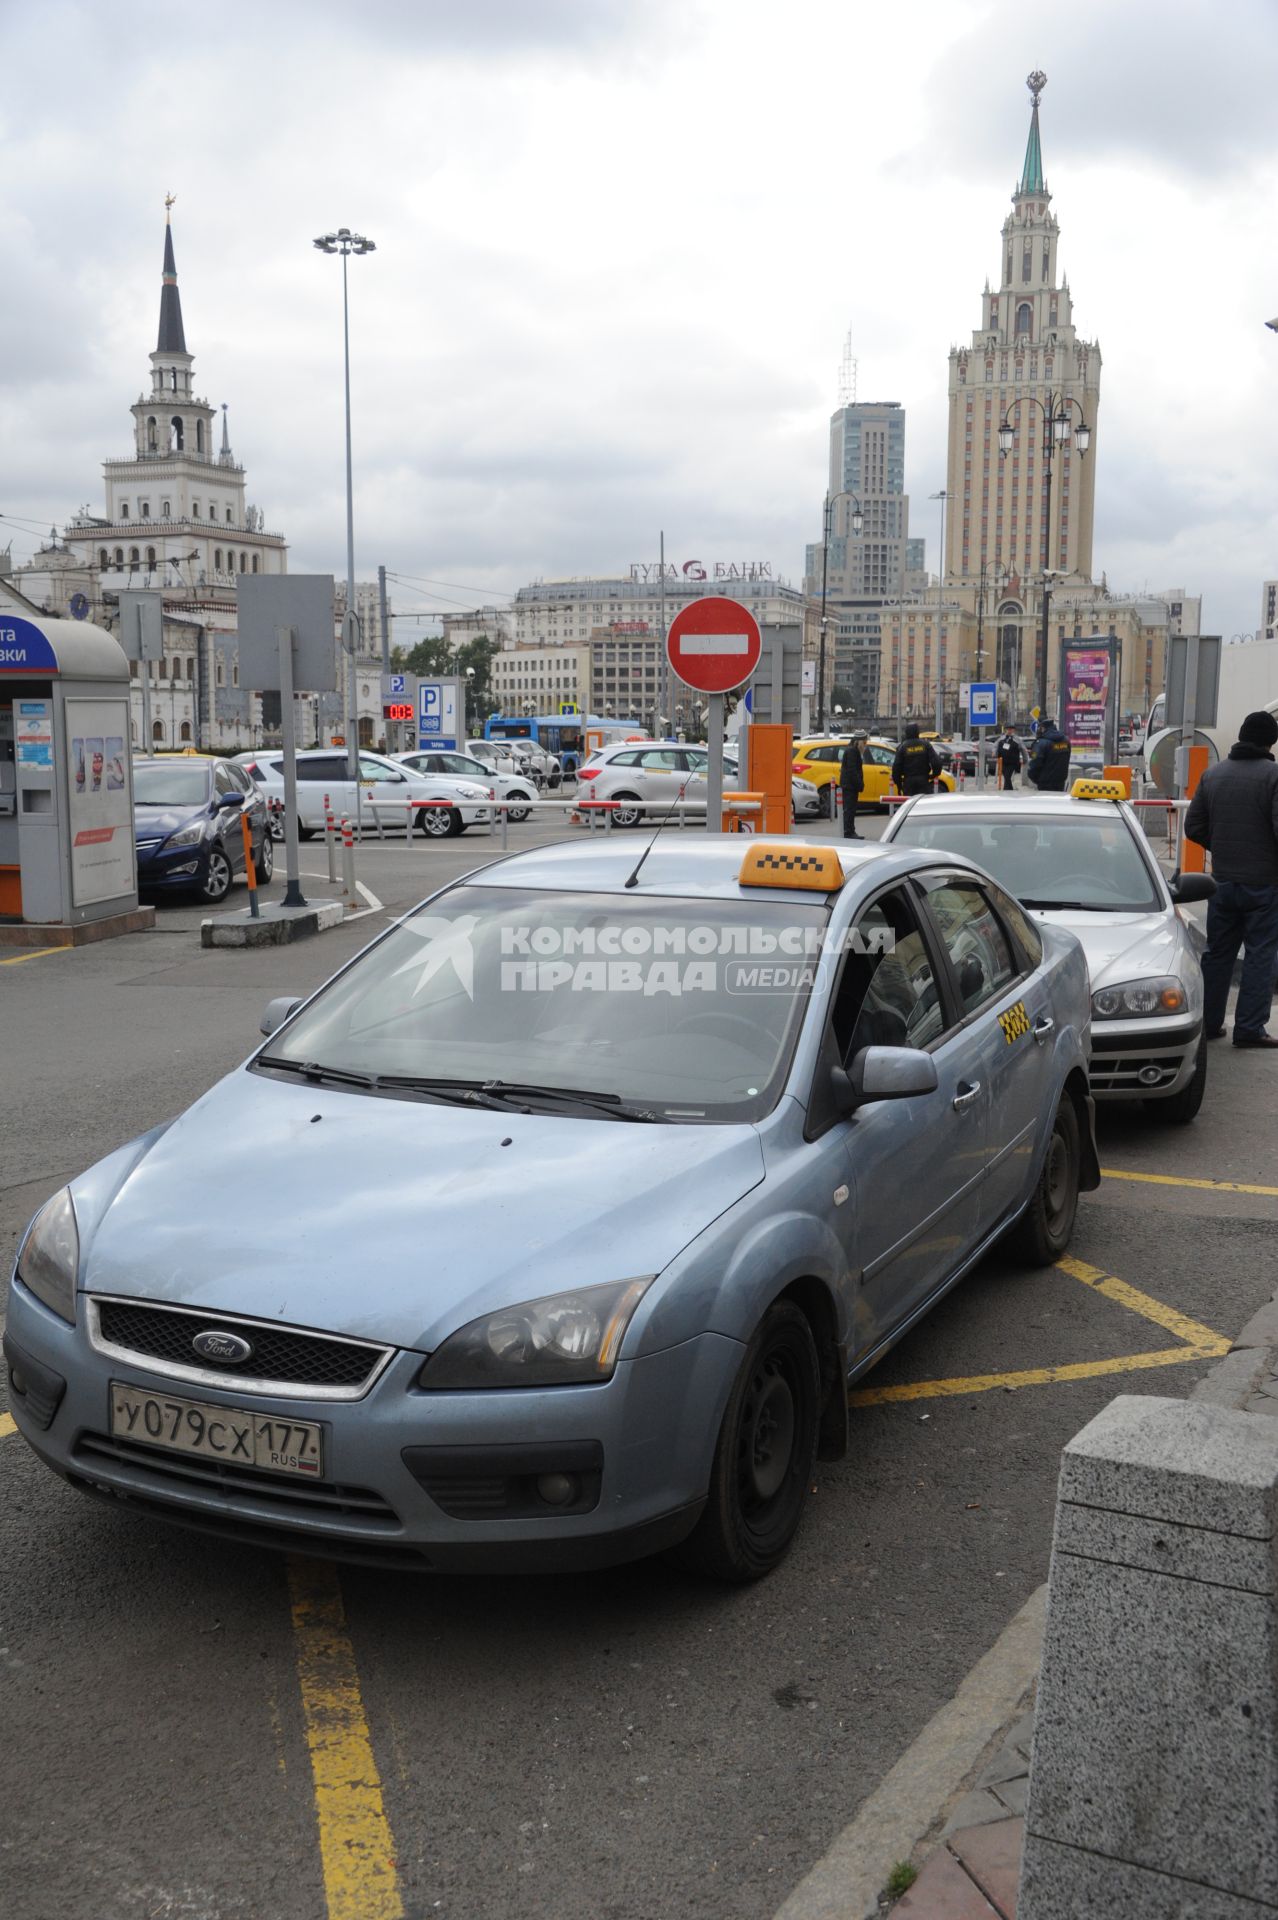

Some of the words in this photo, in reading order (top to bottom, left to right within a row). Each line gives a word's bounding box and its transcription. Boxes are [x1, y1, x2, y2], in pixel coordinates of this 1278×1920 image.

[630, 563, 679, 578] ГУТА
[714, 561, 772, 577] БАНК
[390, 704, 414, 720] 003
[204, 1336, 235, 1357] Ford
[256, 1421, 310, 1456] 177
[271, 1452, 297, 1467] RUS
